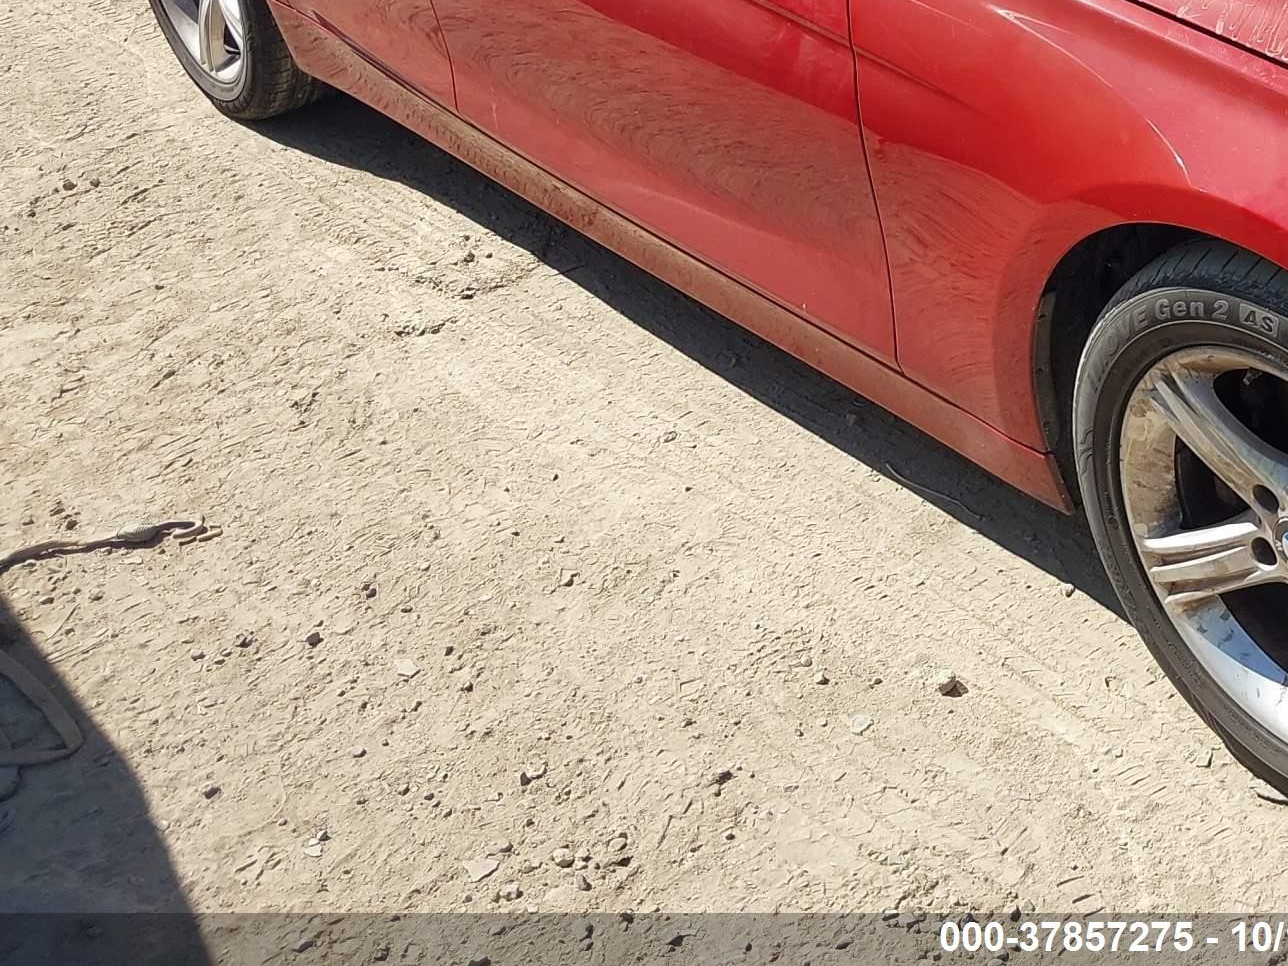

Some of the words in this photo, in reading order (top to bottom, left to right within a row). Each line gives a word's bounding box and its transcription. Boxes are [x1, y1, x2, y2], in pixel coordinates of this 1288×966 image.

[1154, 298, 1205, 320] Gen
[1211, 299, 1230, 320] 2
[1241, 307, 1277, 335] AS
